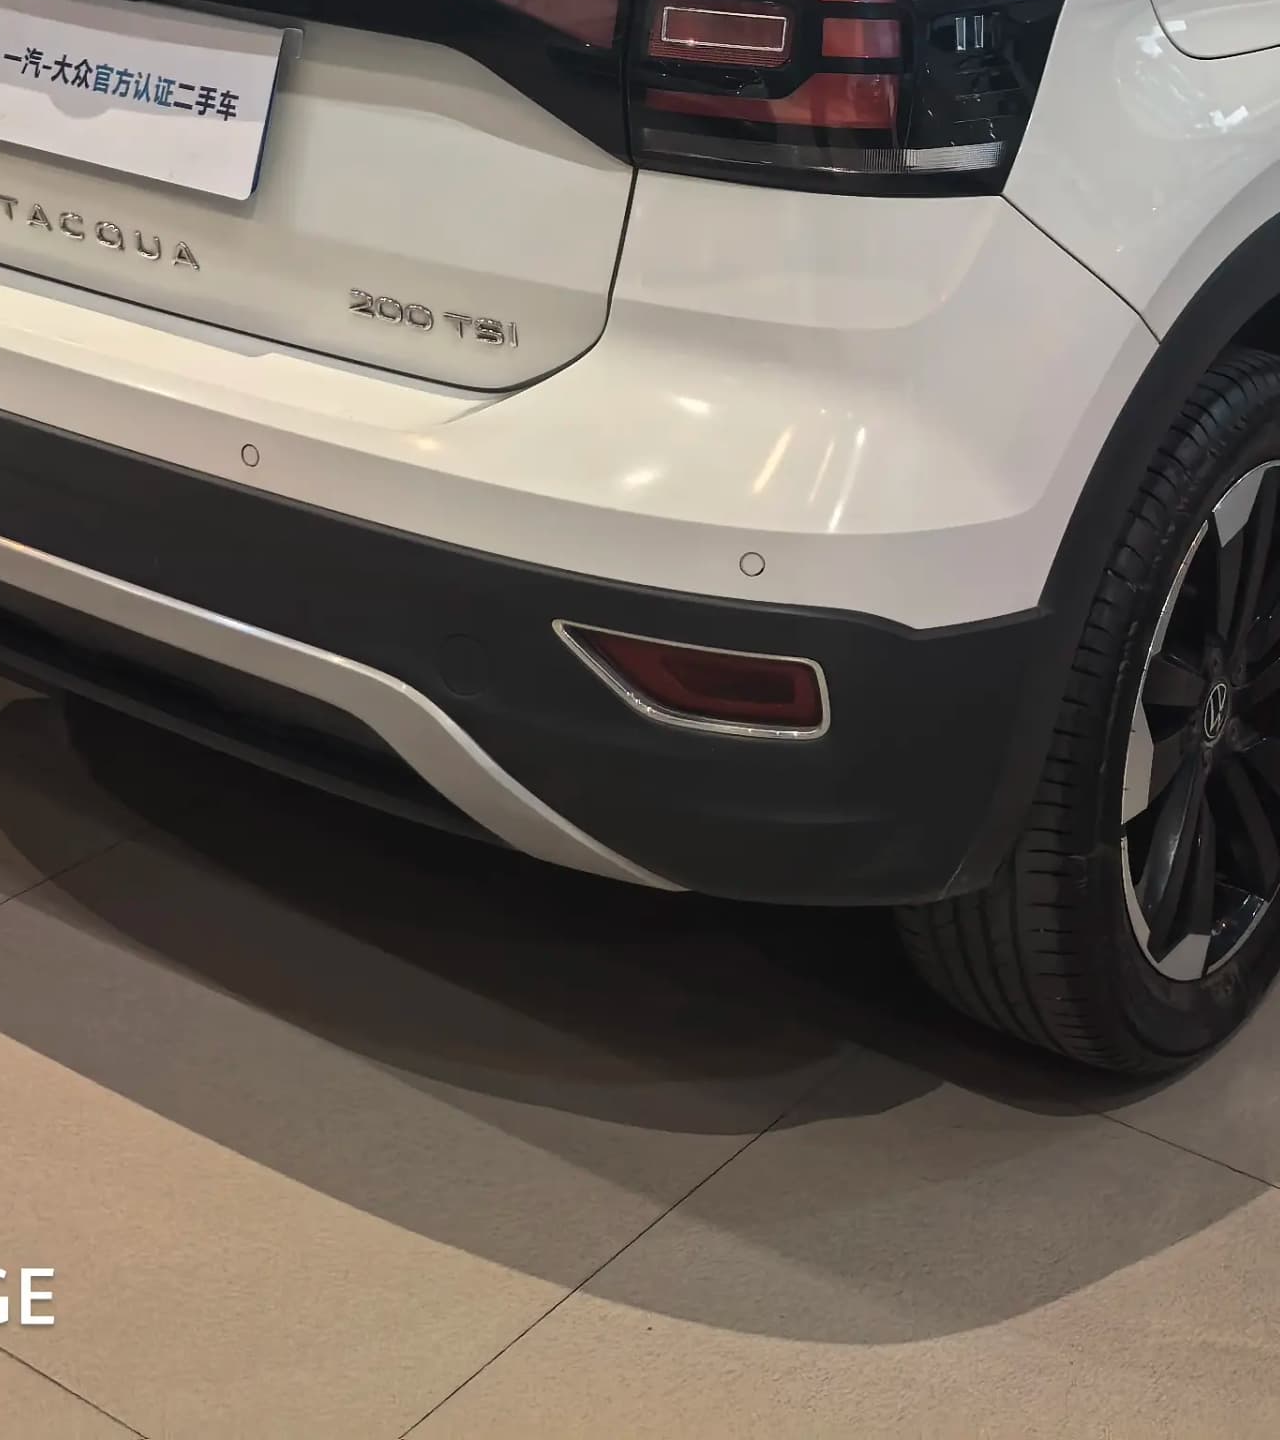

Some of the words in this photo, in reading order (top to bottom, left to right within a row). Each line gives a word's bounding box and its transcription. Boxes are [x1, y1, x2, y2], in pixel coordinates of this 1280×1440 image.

[4, 46, 240, 122] 一汽-大众官方认证二手车
[348, 288, 434, 332] 200
[444, 311, 520, 349] TSI
